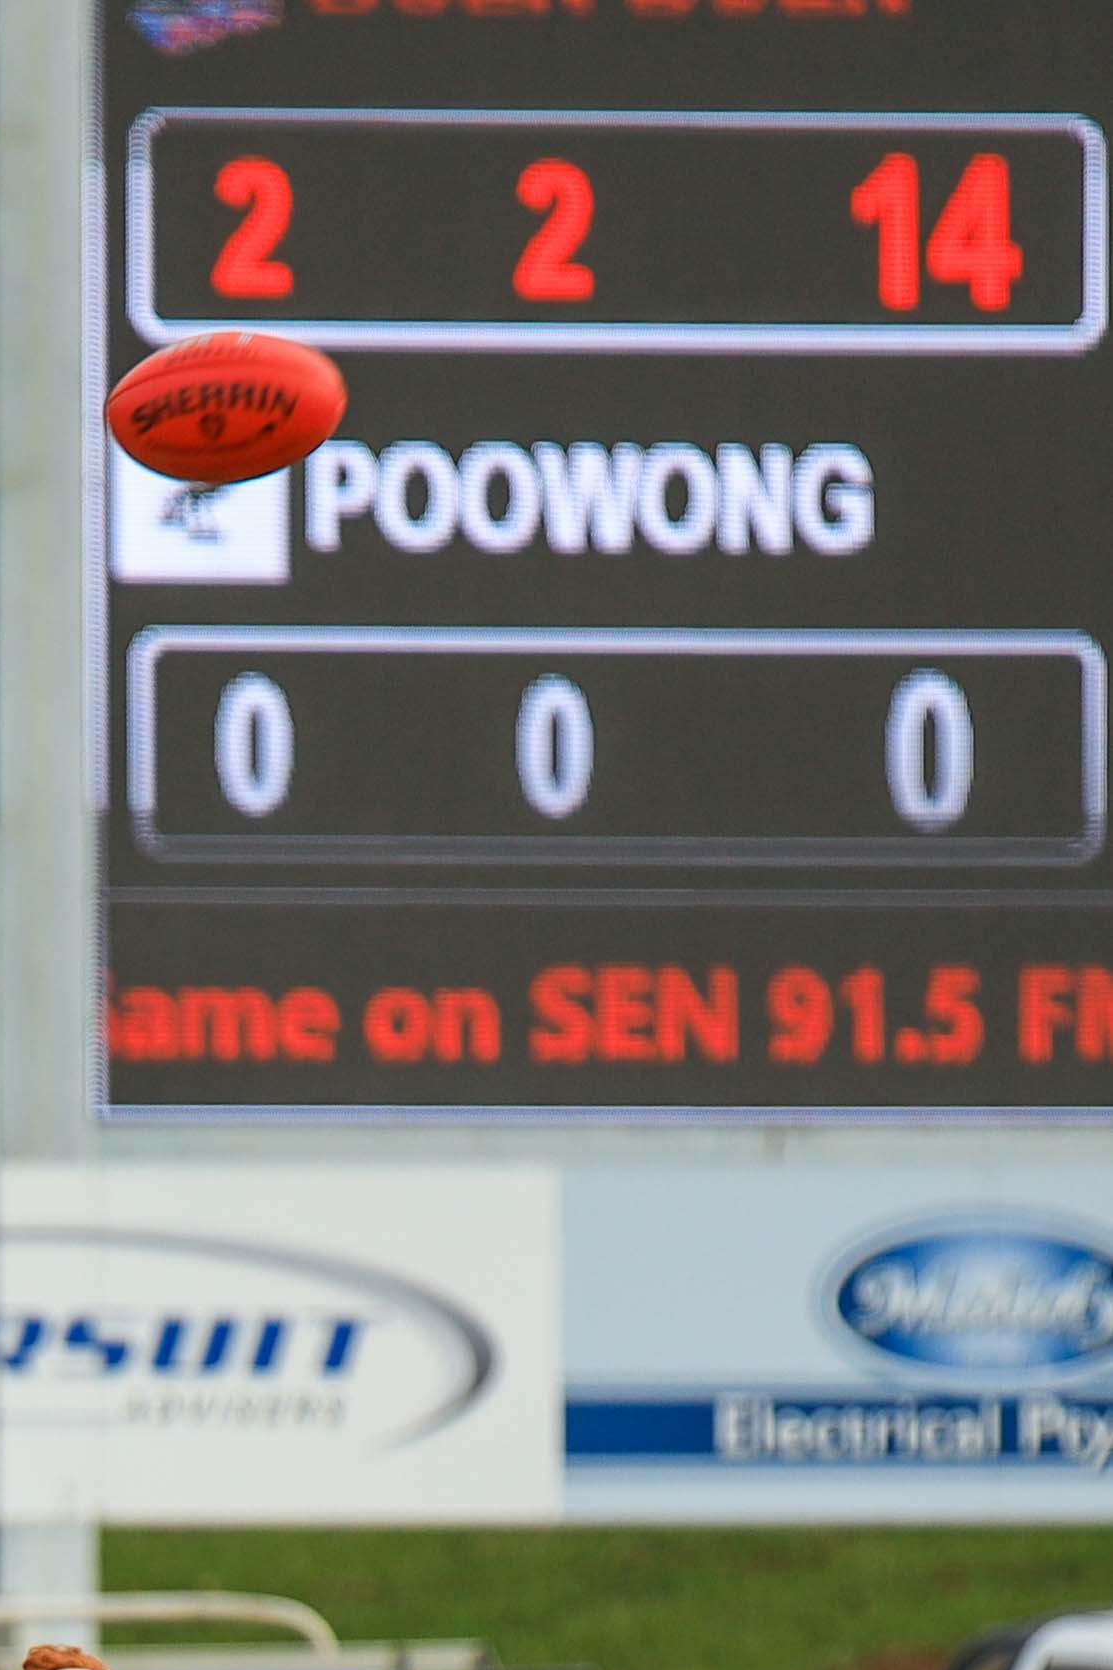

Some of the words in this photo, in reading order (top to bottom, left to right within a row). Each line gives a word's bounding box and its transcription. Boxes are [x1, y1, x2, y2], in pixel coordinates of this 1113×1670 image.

[211, 155, 293, 299] 2
[513, 158, 594, 301] 2
[851, 152, 1023, 311] 14
[130, 382, 300, 435] SHERRIN
[305, 440, 875, 556] POOWONG
[214, 670, 293, 817] 0
[515, 673, 593, 819] 0
[886, 668, 973, 832] 0
[108, 970, 341, 1062] ame
[364, 986, 500, 1063] on
[529, 962, 739, 1063] SEN
[768, 963, 984, 1066] 91.5
[714, 1391, 1001, 1459] Electrical
